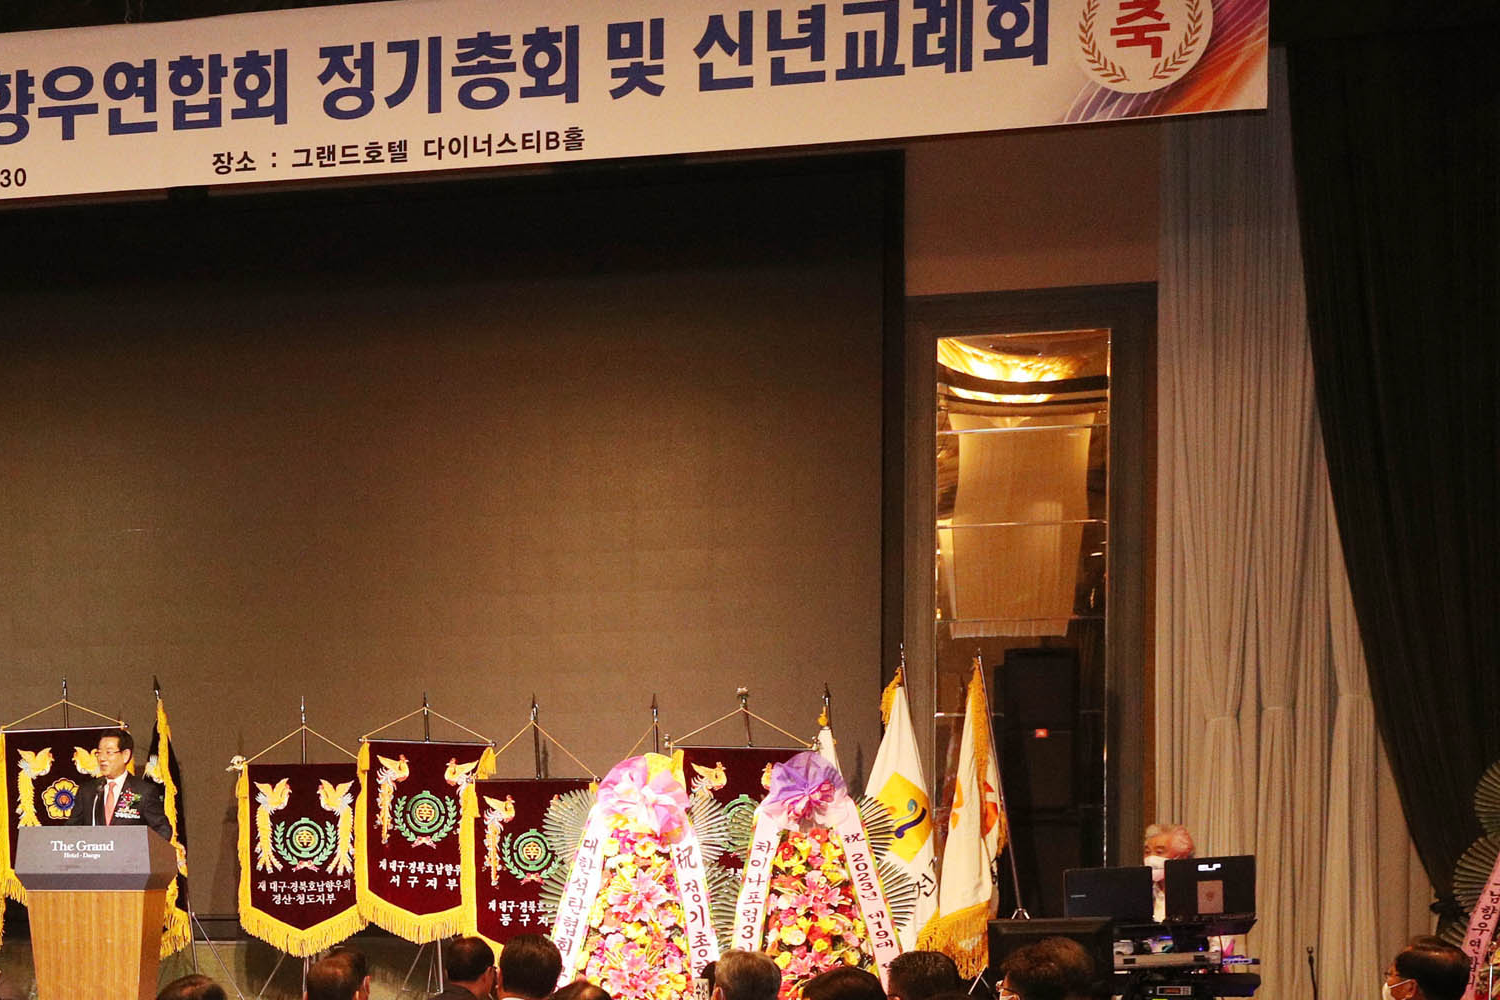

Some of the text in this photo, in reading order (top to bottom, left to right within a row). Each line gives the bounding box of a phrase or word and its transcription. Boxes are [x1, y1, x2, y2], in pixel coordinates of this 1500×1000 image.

[1109, 0, 1171, 59] 축
[316, 24, 579, 121] 정기총회
[606, 17, 666, 101] 및
[692, 0, 1050, 93] 신년교례회
[211, 150, 257, 176] 장소
[291, 138, 409, 170] 그랜드호텔
[423, 126, 586, 160] 다이너스티B홀
[50, 840, 115, 852] The Grand
